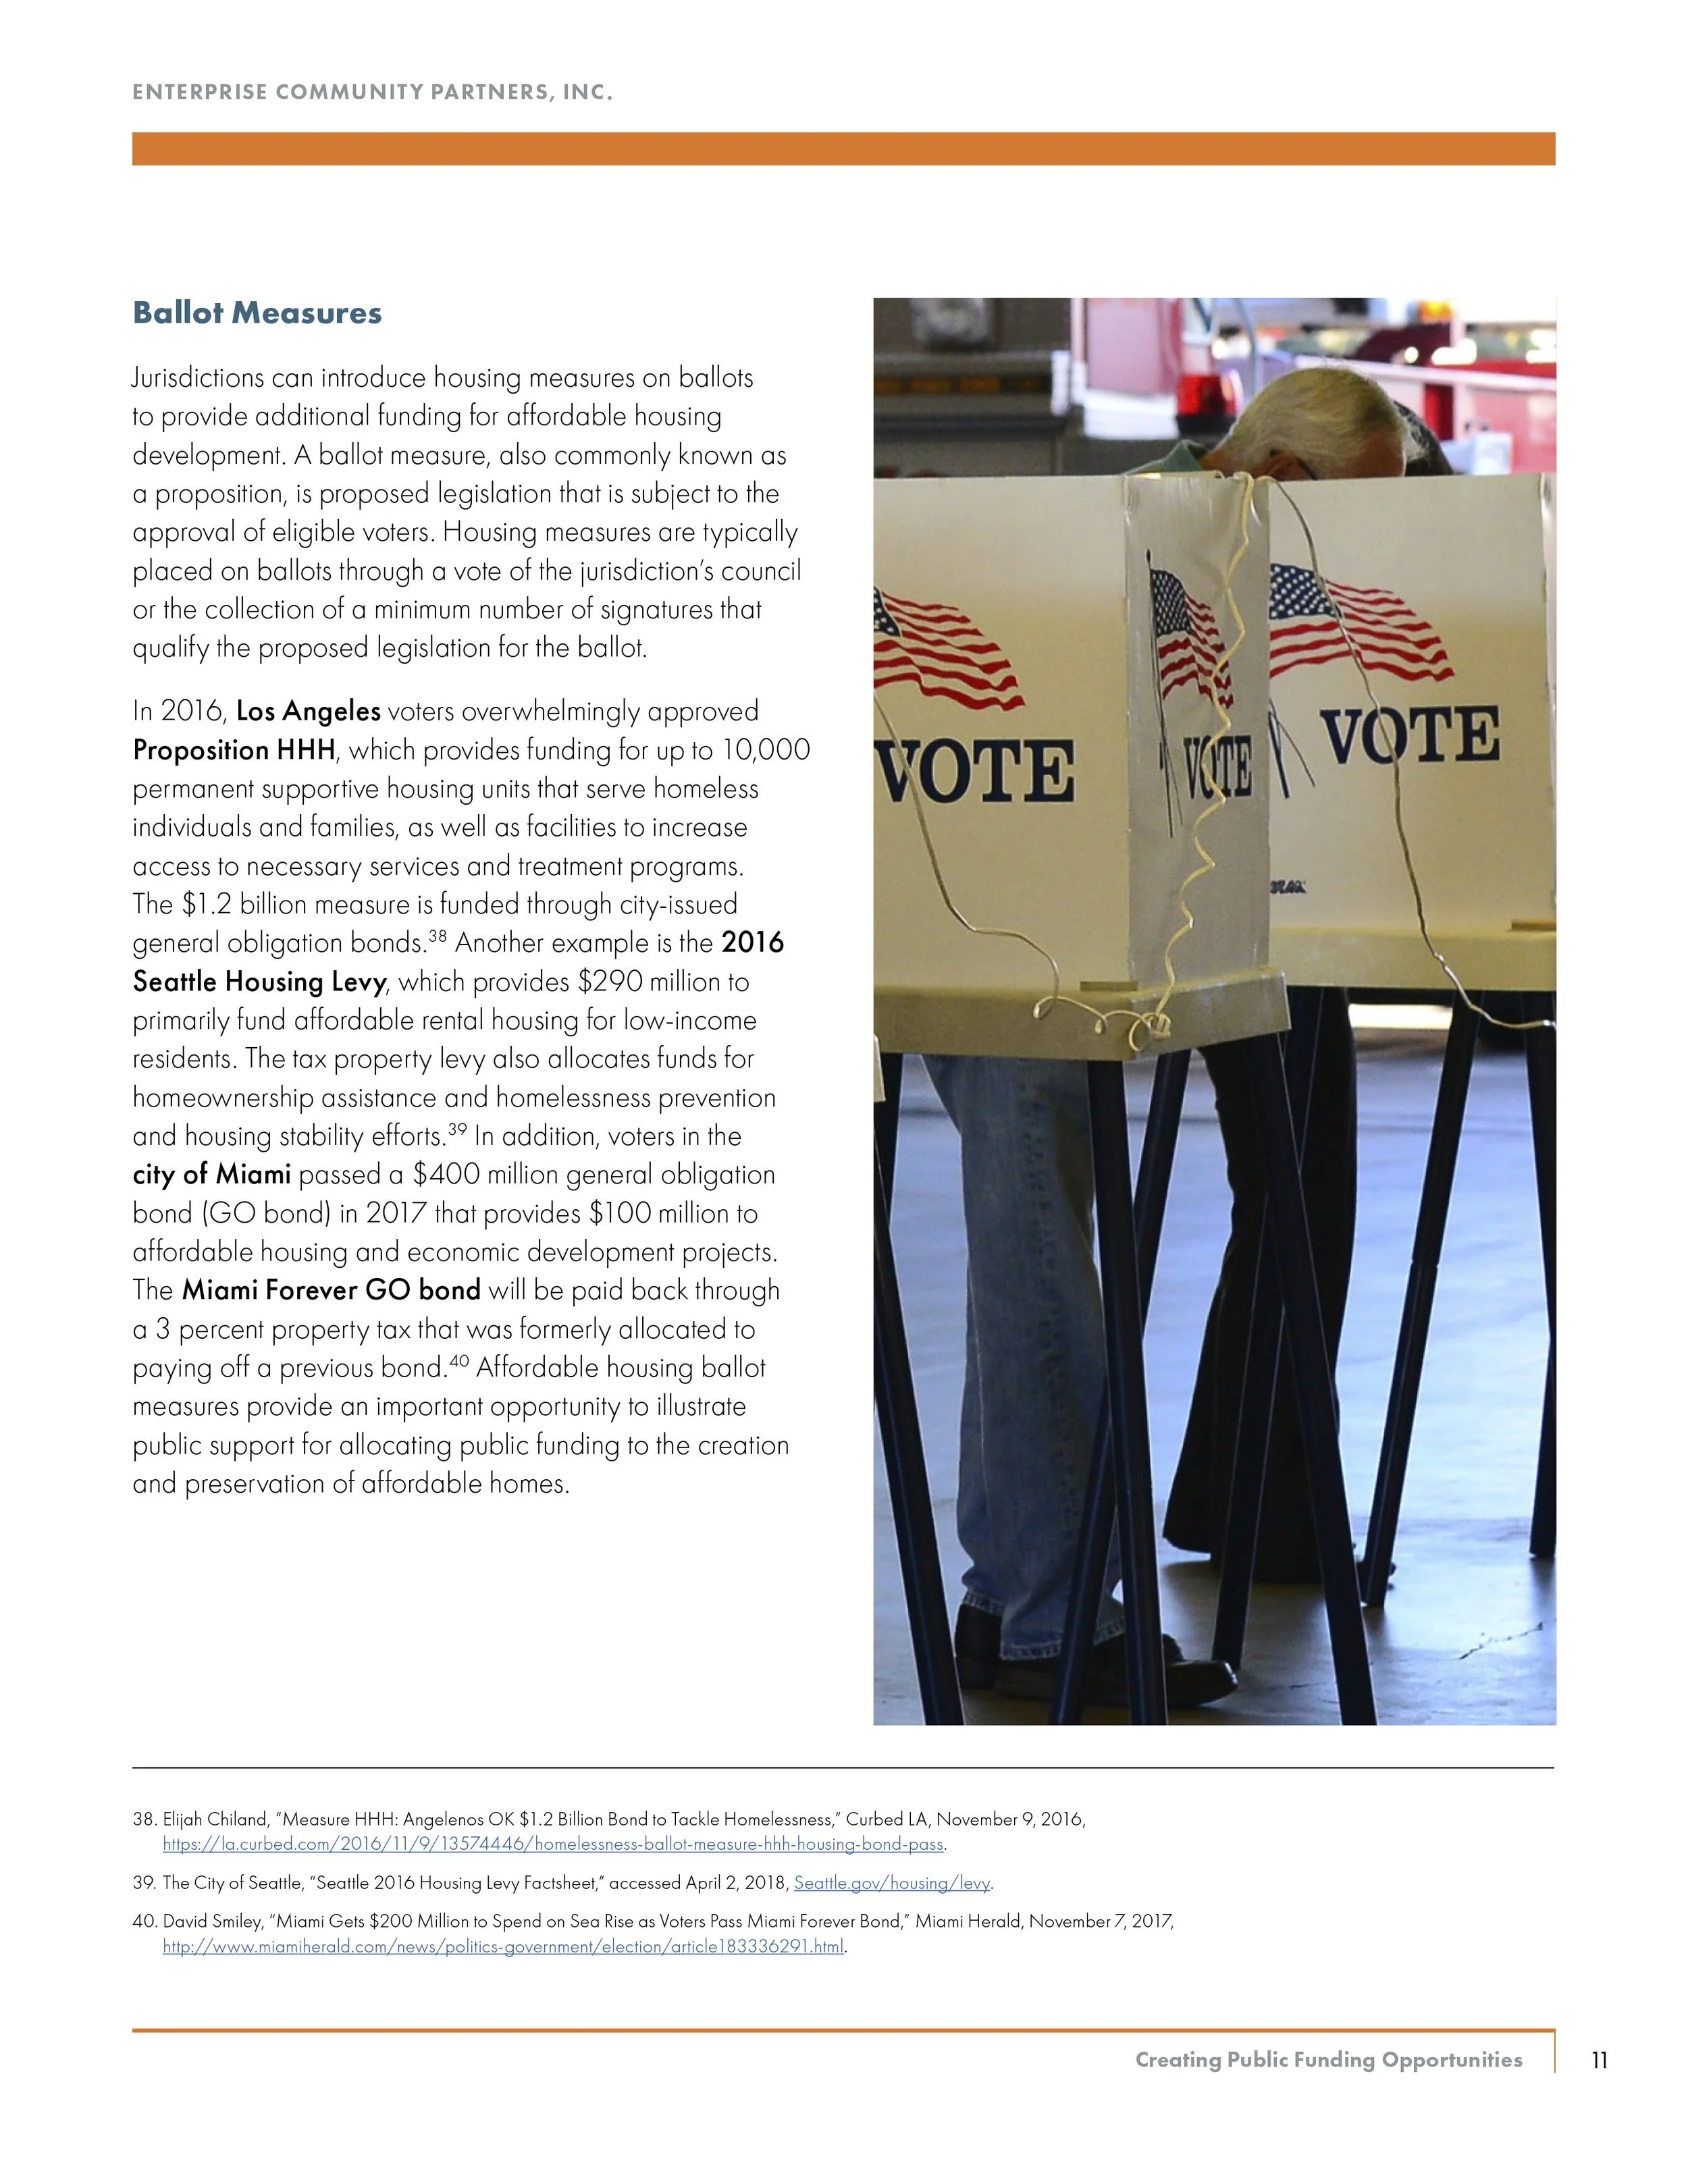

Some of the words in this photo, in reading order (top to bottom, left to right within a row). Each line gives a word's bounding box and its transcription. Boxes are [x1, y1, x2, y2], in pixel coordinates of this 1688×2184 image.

[134, 84, 266, 99] ENTERPRISE
[277, 84, 423, 99] COMMUNITY
[432, 84, 554, 102] PARTNERS,
[564, 84, 612, 100] INC.
[134, 299, 223, 324] Ballot
[232, 301, 381, 324] Measures
[131, 365, 263, 388] Jurisdictions
[273, 373, 312, 388] can
[322, 365, 425, 388] introduce
[436, 365, 520, 394] housing
[531, 373, 634, 388] measures
[643, 373, 670, 388] on
[681, 365, 753, 388] ballots
[134, 489, 146, 503] a
[157, 484, 286, 510] proposition,
[297, 485, 311, 503] is
[321, 480, 428, 510] proposed
[440, 481, 550, 510] legislation
[560, 480, 601, 503] that
[609, 484, 623, 503] is
[632, 480, 710, 510] subject
[717, 485, 737, 503] to
[747, 481, 779, 503] the
[134, 605, 156, 619] or
[164, 596, 196, 619] the
[206, 596, 313, 619] collection
[323, 595, 344, 619] of
[352, 605, 365, 619] a
[376, 600, 469, 619] minimum
[481, 596, 563, 619] number
[572, 595, 594, 619] of
[601, 600, 712, 626] signatures
[720, 596, 762, 619] that
[1319, 705, 1500, 764] VOTE
[135, 739, 268, 766] Proposition
[278, 739, 340, 764] HHH,
[349, 737, 414, 760] which
[425, 737, 519, 766] provides
[527, 737, 610, 766] funding
[619, 737, 648, 760] for
[658, 746, 684, 766] up
[692, 742, 712, 760] to
[725, 738, 810, 764] 10,000
[874, 738, 1074, 803] VOTE
[1183, 735, 1251, 799] VOTE
[134, 861, 210, 876] access
[218, 857, 238, 876] to
[248, 861, 362, 882] necessary
[370, 857, 459, 876] services
[468, 853, 509, 876] and
[519, 857, 623, 876] treatment
[631, 861, 743, 882] programs.
[134, 969, 216, 992] Seattle
[227, 970, 322, 998] Housing
[334, 970, 389, 998] Levy,
[398, 969, 464, 992] which
[475, 969, 569, 998] provides
[579, 967, 642, 994] $290
[651, 969, 719, 992] million
[729, 974, 749, 992] to
[134, 1084, 313, 1114] homeownership
[322, 1088, 436, 1107] assistance
[446, 1084, 487, 1107] and
[498, 1084, 650, 1107] homelessness
[660, 1089, 774, 1114] prevention
[134, 1200, 191, 1223] bond
[203, 1200, 255, 1227] (GO
[265, 1200, 329, 1227] bond)
[341, 1204, 357, 1223] in
[367, 1201, 427, 1223] 2017
[436, 1200, 477, 1223] that
[485, 1200, 580, 1230] provides
[589, 1199, 651, 1226] $100
[660, 1200, 728, 1223] million
[737, 1205, 758, 1223] to
[134, 1325, 146, 1339] a
[157, 1317, 169, 1339] 3
[180, 1321, 264, 1346] percent
[273, 1321, 369, 1346] property
[377, 1321, 411, 1339] tax
[418, 1316, 459, 1339] that
[467, 1325, 512, 1339] was
[520, 1316, 611, 1346] formerly
[619, 1316, 725, 1339] allocated
[735, 1321, 755, 1339] to
[134, 1432, 201, 1462] public
[210, 1437, 294, 1462] support
[302, 1431, 332, 1455] for
[340, 1432, 450, 1462] allocating
[461, 1432, 528, 1462] public
[537, 1431, 618, 1462] funding
[628, 1437, 648, 1455] to
[656, 1432, 689, 1455] the
[699, 1436, 788, 1455] creation
[134, 1812, 157, 1826] 38.
[164, 1811, 201, 1830] Elijah
[208, 1811, 269, 1828] Chiland,
[356, 1812, 398, 1826] HHH:
[403, 1811, 483, 1830] Angelenos
[489, 1812, 515, 1826] OK
[520, 1811, 552, 1828] $1.2
[559, 1811, 602, 1826] Billion
[609, 1811, 647, 1826] Bond
[653, 1815, 666, 1826] to
[671, 1811, 719, 1826] Tackle
[847, 1811, 903, 1826] Curbed
[909, 1811, 931, 1828] LA,
[938, 1811, 1018, 1826] November
[1023, 1812, 1036, 1828] 9,
[1042, 1812, 1085, 1828] 2016,
[134, 1875, 156, 1889] 39.
[163, 1874, 189, 1889] The
[194, 1875, 225, 1894] City
[230, 1874, 244, 1889] of
[249, 1874, 304, 1892] Seattle,
[375, 1875, 415, 1889] 2016
[421, 1875, 481, 1894] Housing
[487, 1875, 519, 1894] Levy
[610, 1874, 680, 1889] accessed
[686, 1874, 720, 1894] April
[727, 1875, 739, 1892] 2,
[745, 1875, 789, 1892] 2018,
[794, 1874, 993, 1894] Seattle.gov/housing/levy.
[132, 1913, 157, 1927] 40.
[164, 1913, 207, 1928] David
[213, 1913, 263, 1932] Smiley,
[329, 1914, 364, 1927] Gets
[370, 1913, 412, 1929] $200
[418, 1913, 468, 1927] Million
[474, 1916, 487, 1927] to
[493, 1913, 541, 1932] Spend
[547, 1919, 564, 1927] on
[571, 1914, 599, 1927] Sea
[606, 1914, 633, 1927] Rise
[639, 1919, 655, 1927] as
[660, 1914, 705, 1927] Voters
[712, 1914, 742, 1927] Pass
[748, 1913, 795, 1927] Miami
[801, 1914, 855, 1928] Forever
[916, 1913, 963, 1927] Miami
[969, 1913, 1024, 1930] Herald,
[1030, 1913, 1111, 1927] November
[1115, 1914, 1126, 1930] 7,
[1133, 1914, 1173, 1930] 2017,
[1136, 2051, 1221, 2072] Creating
[1229, 2050, 1288, 2067] Public
[1296, 2050, 1374, 2072] Funding
[1383, 2051, 1523, 2072] Opportunities
[1593, 2052, 1606, 2069] 11
